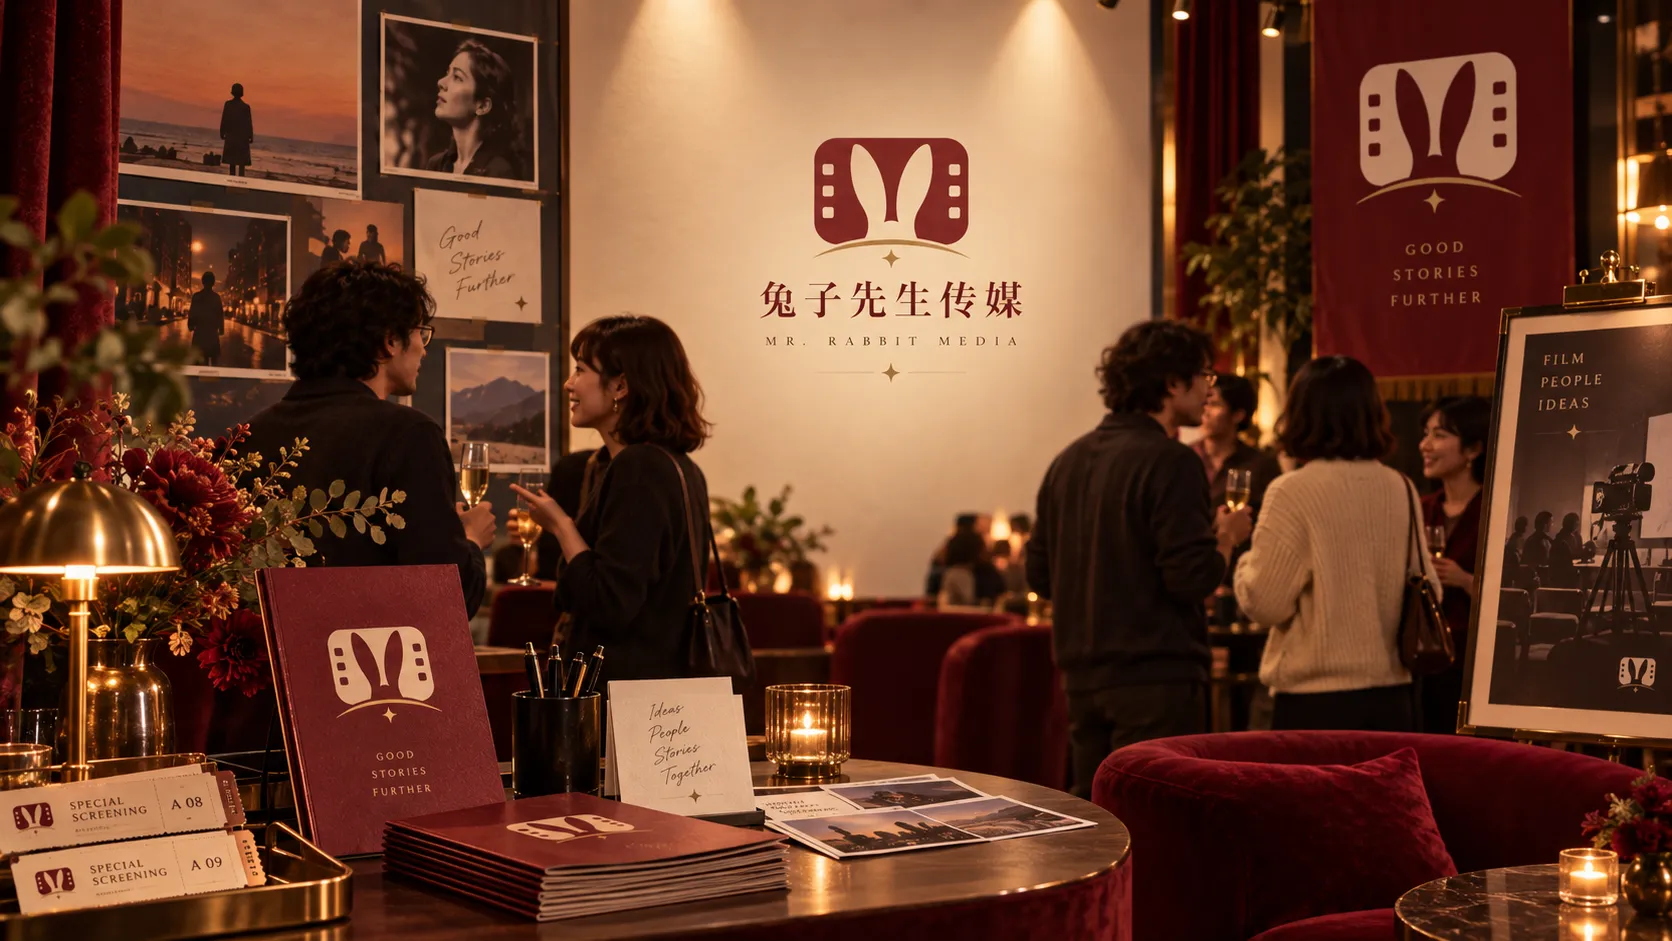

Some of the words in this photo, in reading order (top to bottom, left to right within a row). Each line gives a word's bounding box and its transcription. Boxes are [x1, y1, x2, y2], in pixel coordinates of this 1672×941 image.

[439, 220, 483, 249] Good
[1405, 241, 1463, 255] GOOD
[449, 250, 505, 275] Stories
[1393, 265, 1478, 281] STORIES
[456, 269, 516, 300] Further
[760, 280, 1023, 319] 兔子先生传媒
[1391, 291, 1480, 307] FURTHER
[765, 336, 806, 346] MR.
[828, 336, 918, 346] RABBIT
[938, 336, 1018, 346] MEDIA
[1543, 352, 1584, 366] FILM
[1541, 373, 1602, 388] PEOPLE
[1538, 397, 1589, 411] IDEAS
[649, 702, 684, 720] Ideas
[648, 720, 690, 743] People
[376, 750, 414, 761] GOOD
[654, 744, 700, 766] Stories
[371, 766, 426, 779] STORIES
[660, 760, 716, 787] Together
[372, 784, 431, 797] FURTHER
[69, 796, 124, 810] SPECIAL
[171, 799, 182, 810] A
[185, 796, 203, 808] 08
[72, 805, 147, 822] SCREENING
[89, 859, 144, 874] SPECIAL
[191, 860, 201, 871] A
[205, 857, 222, 869] 09
[92, 868, 167, 886] SCREENING
